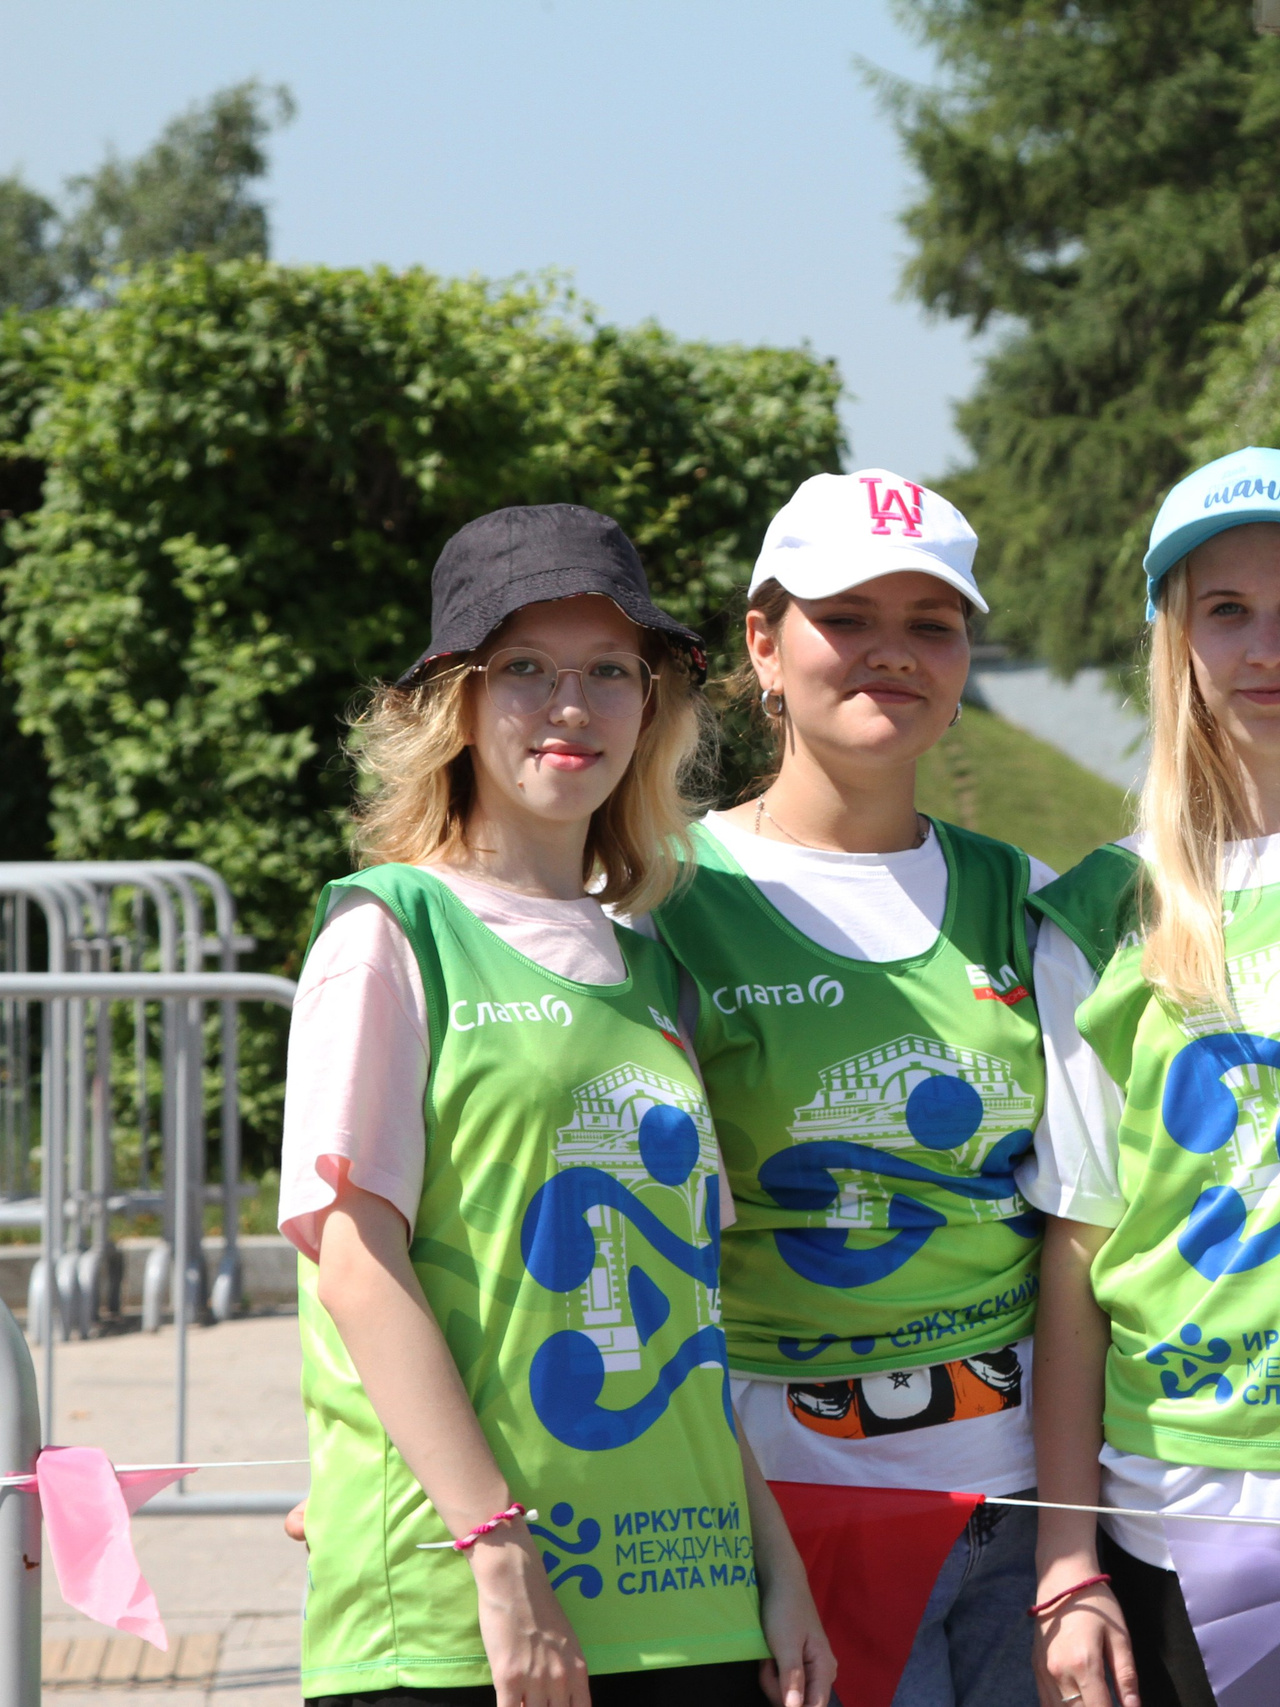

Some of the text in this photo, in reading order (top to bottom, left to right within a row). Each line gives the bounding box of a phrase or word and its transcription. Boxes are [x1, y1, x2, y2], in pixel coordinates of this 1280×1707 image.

[713, 983, 804, 1014] Слата
[450, 1000, 542, 1032] Слата
[617, 1565, 705, 1595] СЛАТА
